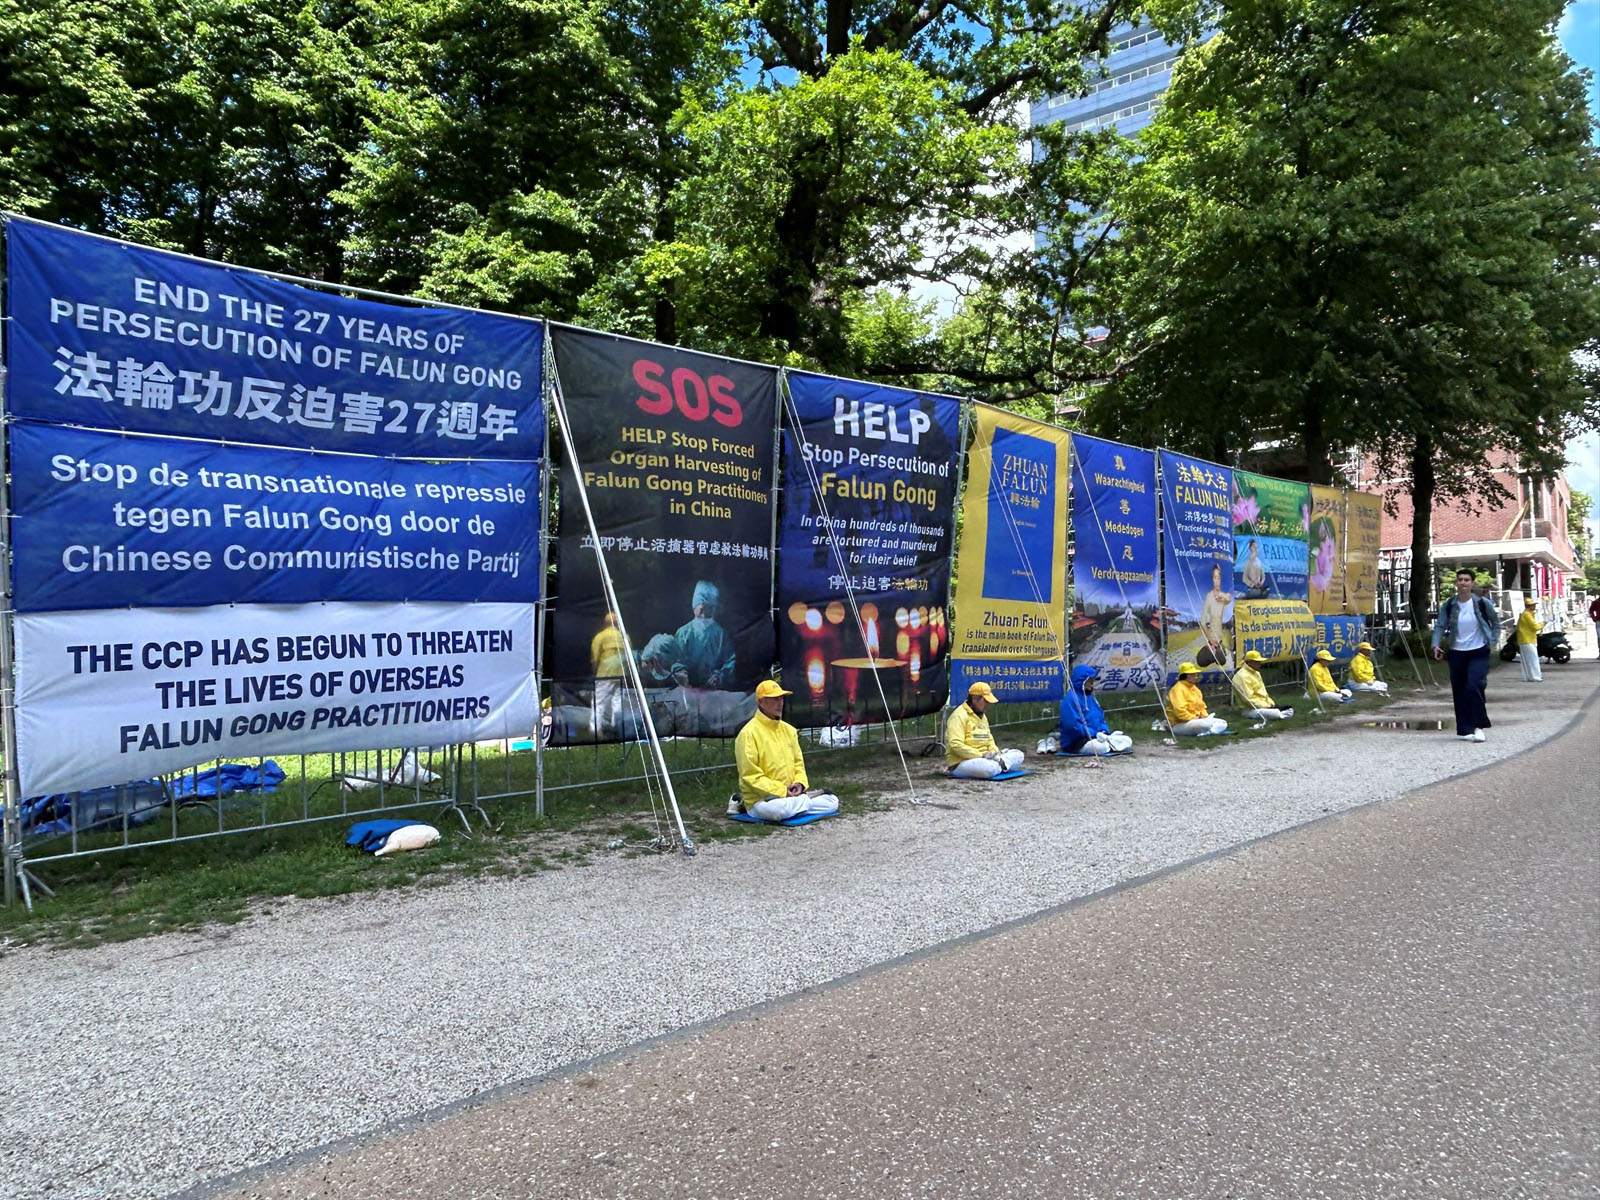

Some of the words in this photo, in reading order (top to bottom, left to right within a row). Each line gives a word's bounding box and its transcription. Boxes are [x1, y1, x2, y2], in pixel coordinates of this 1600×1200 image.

[135, 277, 209, 313] END
[218, 294, 284, 328] THE
[294, 310, 330, 335] 27
[338, 315, 428, 350] YEARS
[435, 333, 464, 354] OF
[50, 298, 301, 364] PERSECUTION
[312, 346, 352, 370] OF
[360, 352, 446, 383] FALUN
[453, 365, 522, 390] GONG
[52, 346, 518, 441] 法輪功反迫害27週年
[632, 359, 743, 427] SOS
[834, 397, 931, 445] HELP
[621, 427, 667, 444] HELP
[671, 432, 708, 451] Stop
[711, 438, 755, 458] Forced
[610, 450, 669, 469] Organ
[674, 454, 749, 481] Harvesting
[752, 467, 762, 481] of
[802, 442, 843, 468] Stop
[848, 447, 936, 475] Persecution
[938, 461, 949, 477] of
[1002, 454, 1048, 478] ZHUAN
[50, 454, 138, 489] Stop
[149, 463, 188, 487] de
[198, 467, 406, 499] transnationale
[415, 483, 526, 504] repressie
[584, 472, 640, 489] Falun
[646, 475, 693, 496] Gong
[697, 479, 767, 504] Practitioners
[821, 472, 886, 500] Falun
[893, 479, 936, 511] Gong
[1001, 471, 1047, 495] FALUN
[1094, 473, 1145, 494] Waarachtigheid
[670, 498, 686, 514] in
[691, 501, 732, 519] China
[1175, 485, 1212, 508] FALUN
[113, 501, 211, 533] tegen
[223, 503, 309, 529] Falun
[319, 507, 392, 536] Gong
[400, 510, 460, 533] door
[467, 515, 495, 535] de
[800, 514, 812, 527] In
[816, 515, 847, 529] China
[850, 517, 897, 532] hundreds
[899, 522, 908, 532] of
[909, 523, 944, 537] thousands
[1105, 520, 1144, 538] Mededogen
[812, 535, 831, 545] are
[835, 535, 880, 548] tortured
[882, 538, 898, 549] and
[901, 540, 937, 552] murdered
[849, 552, 865, 564] for
[868, 553, 890, 565] their
[893, 555, 918, 566] belief
[62, 545, 212, 572] Chinese
[223, 544, 460, 570] Communistische
[467, 549, 520, 578] Partij
[966, 629, 973, 639] is
[975, 629, 987, 640] the
[989, 631, 1006, 640] main
[1007, 630, 1021, 640] book
[1023, 632, 1030, 641] of
[1030, 632, 1046, 641] Falun
[984, 611, 1018, 627] Zhuan
[1022, 614, 1048, 629] Falun
[1250, 620, 1261, 632] de
[67, 643, 133, 673] THE
[142, 640, 203, 669] CCP
[211, 637, 269, 665] HAS
[277, 634, 366, 661] BEGUN
[372, 633, 401, 657] TO
[407, 630, 512, 655] THREATEN
[962, 643, 999, 653] translated
[1000, 644, 1007, 653] in
[1008, 646, 1023, 654] over
[155, 679, 216, 709] THE
[225, 674, 302, 704] LIVES
[310, 671, 344, 697] OF
[350, 665, 464, 694] OVERSEAS
[120, 718, 223, 753] FALUN
[230, 710, 305, 737] GONG
[310, 696, 490, 730] PRACTITIONERS
